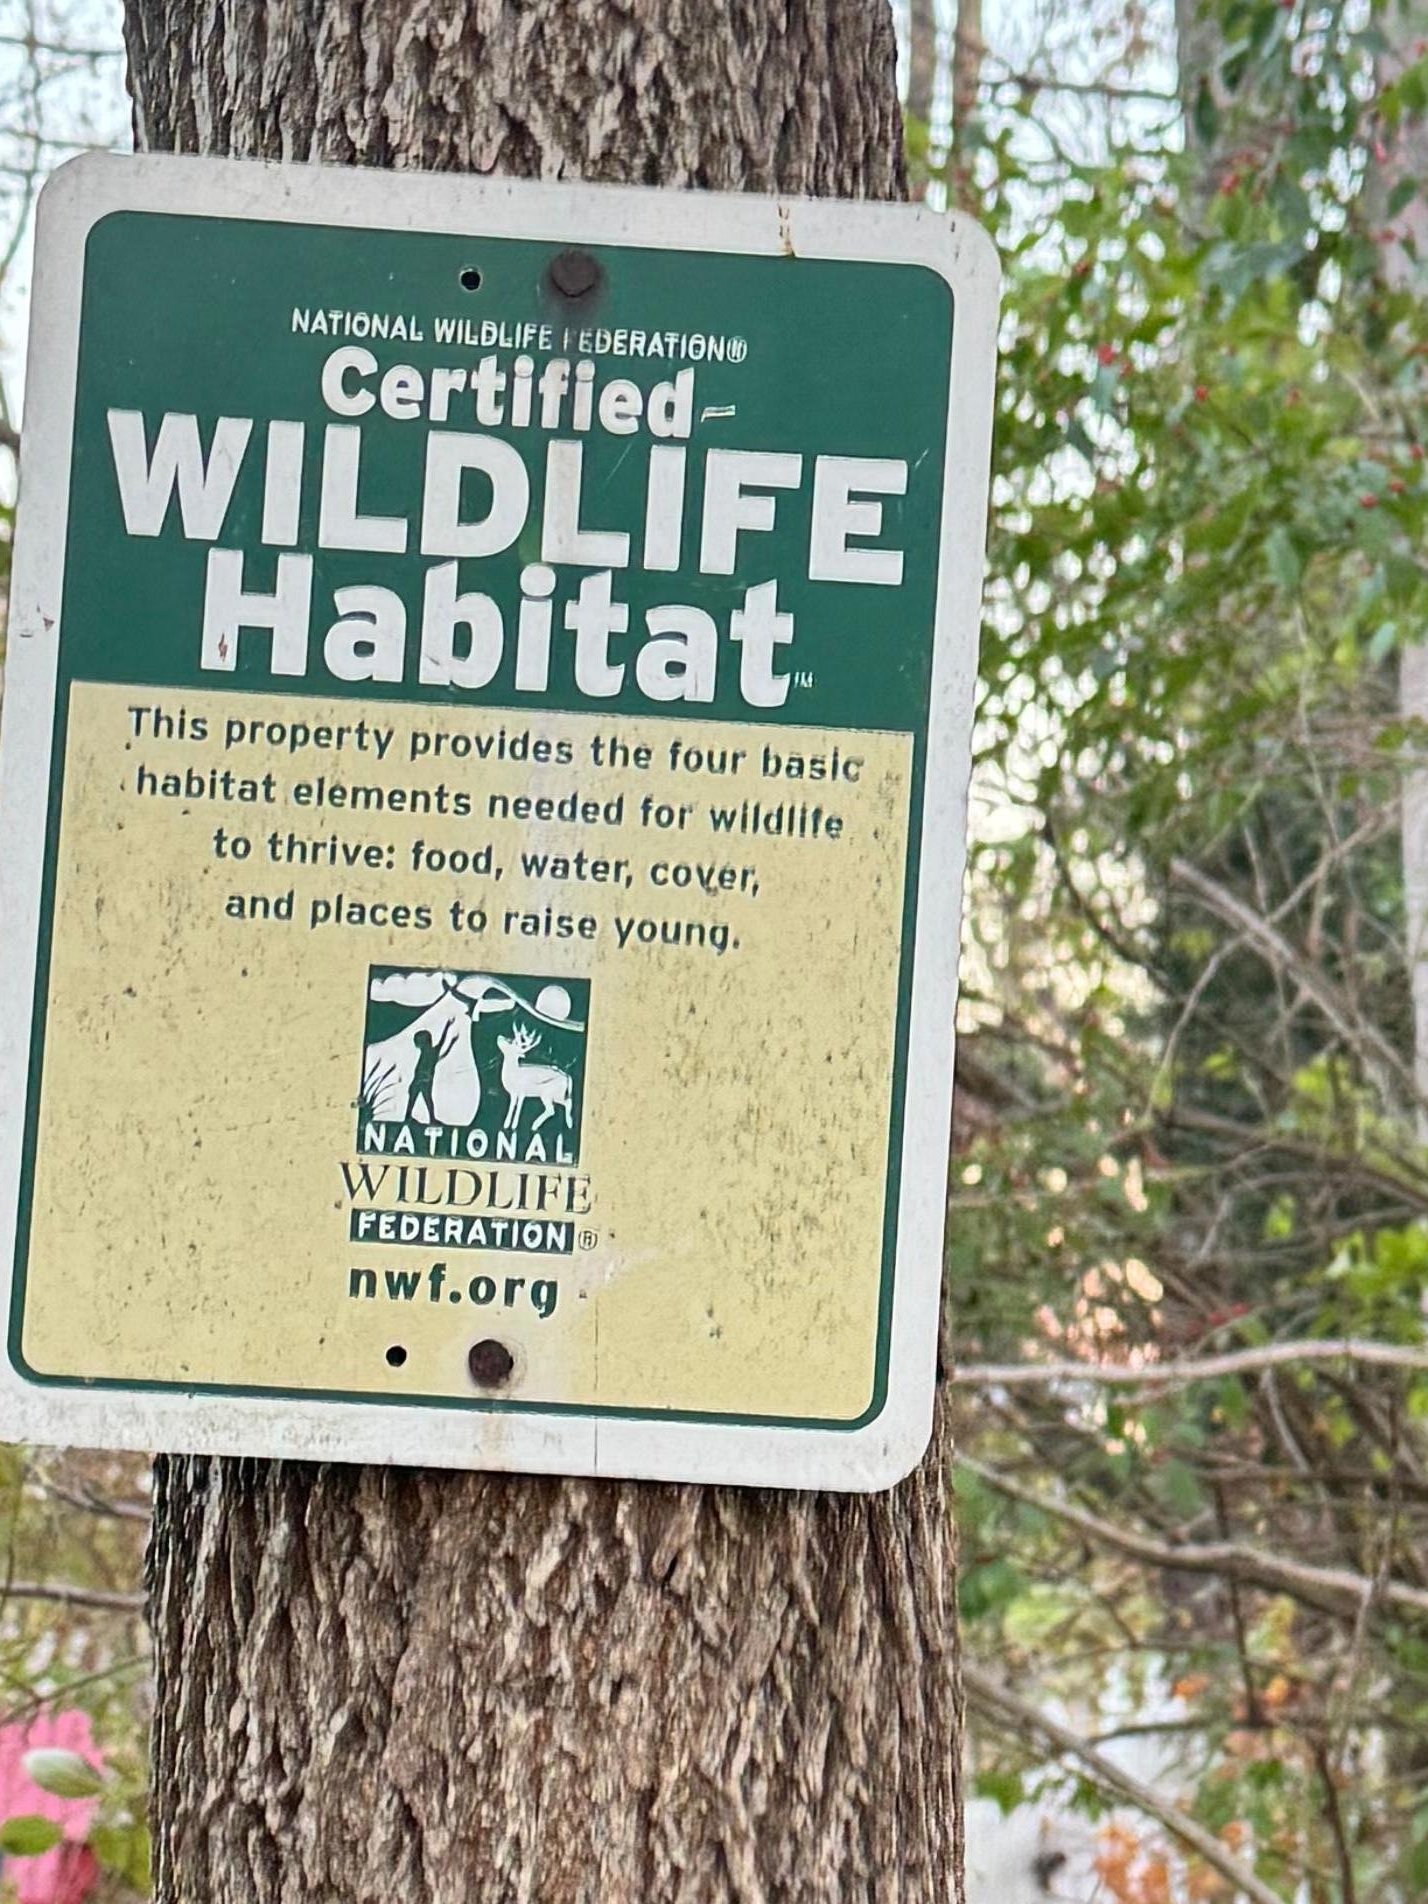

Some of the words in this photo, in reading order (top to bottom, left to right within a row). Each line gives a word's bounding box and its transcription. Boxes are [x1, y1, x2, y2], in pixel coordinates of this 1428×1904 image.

[291, 307, 424, 342] NATIONAL
[434, 316, 553, 351] WILDLIFE
[321, 345, 696, 439] Certified
[106, 407, 909, 587] WILDLIFE
[127, 705, 209, 742] This
[225, 717, 395, 761] property
[410, 728, 574, 764] provides
[590, 735, 653, 770] the
[669, 739, 747, 777] four
[761, 744, 866, 784] basic
[136, 764, 277, 804] habitat
[293, 776, 473, 817] elements
[488, 791, 625, 827] needed
[640, 793, 693, 831] for
[709, 798, 844, 841] wildlife
[212, 827, 252, 860] to
[267, 831, 396, 870] thrive:
[411, 839, 504, 882] food,
[521, 850, 634, 889] water,
[650, 860, 761, 898] cover,
[225, 888, 295, 922] and
[310, 892, 433, 930] places
[449, 900, 488, 934] to
[503, 906, 598, 940] raise
[614, 915, 741, 957] young.
[363, 1123, 574, 1163] NATIONAL
[338, 1160, 593, 1215] WILDLIFE
[348, 1261, 560, 1319] nwf.org
